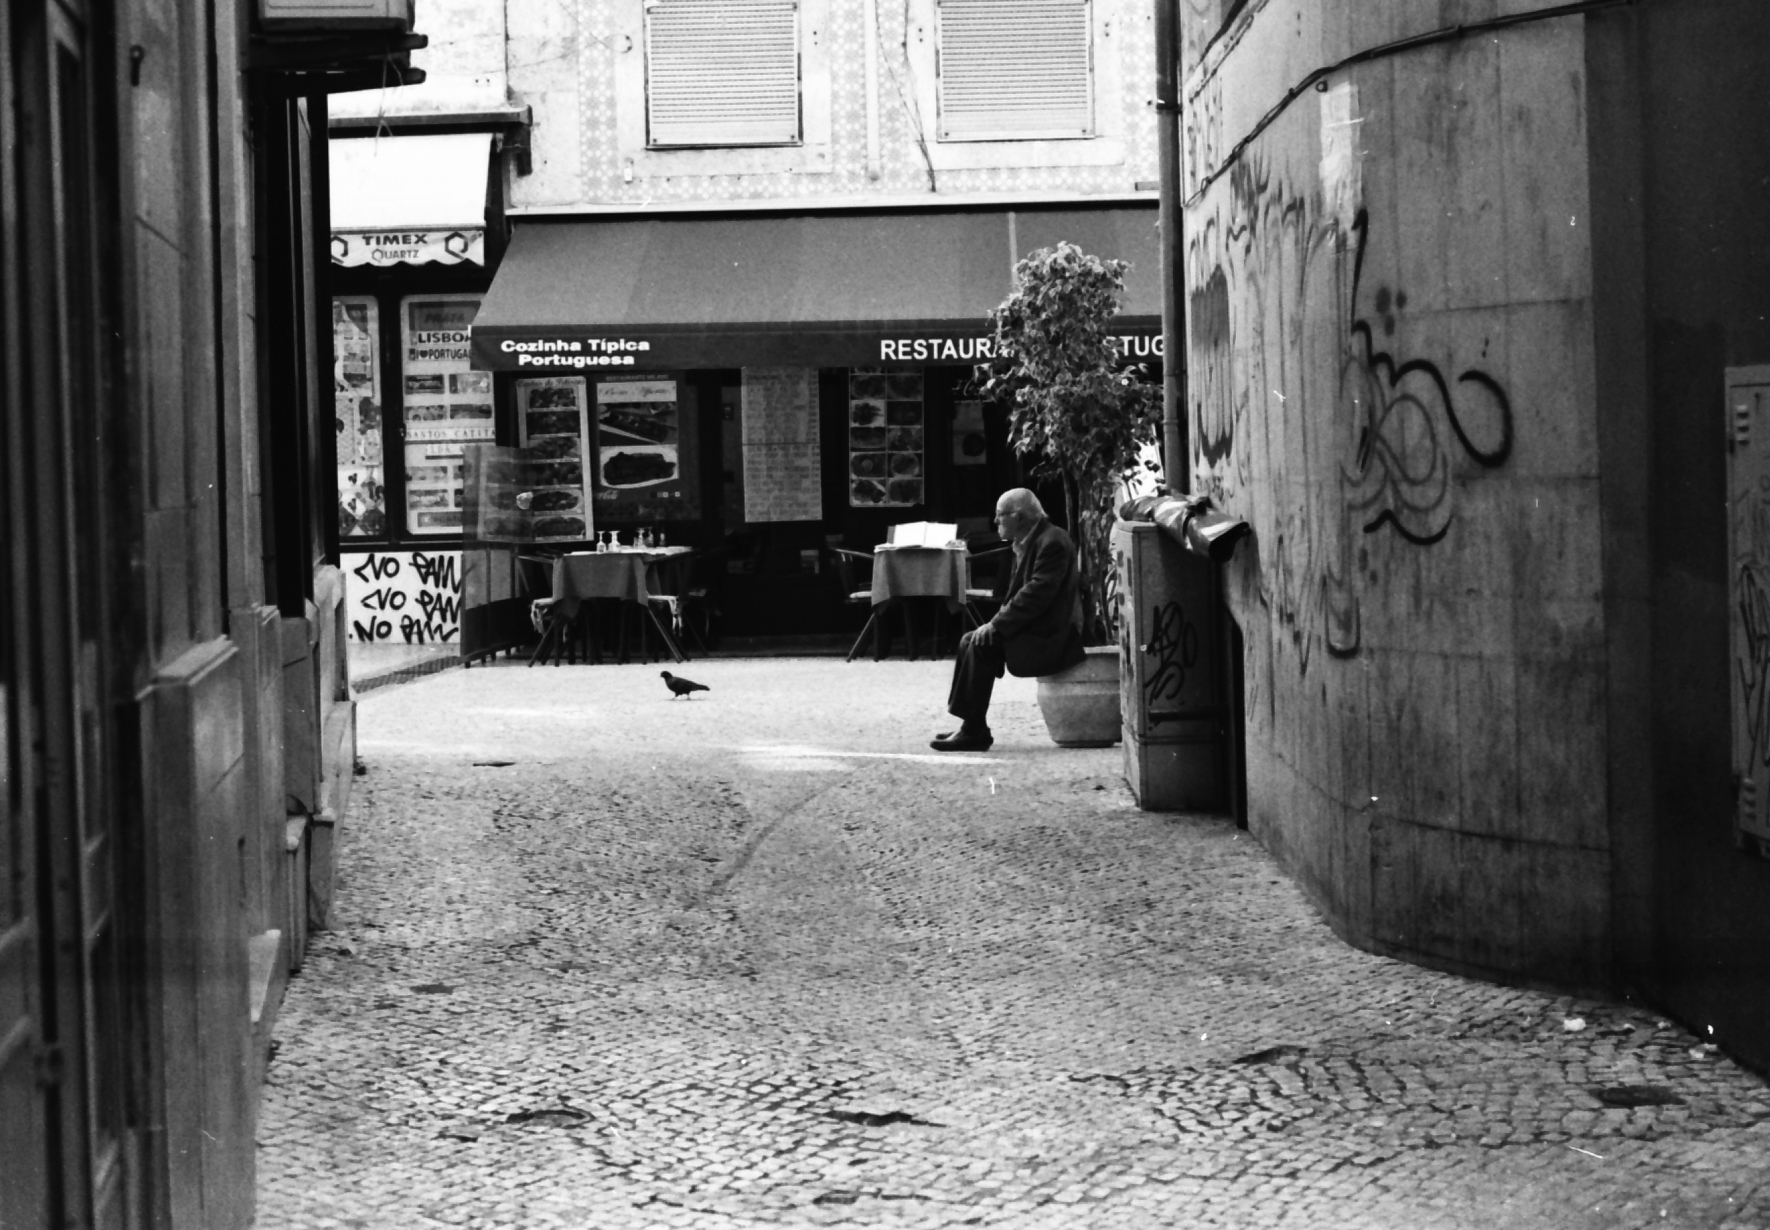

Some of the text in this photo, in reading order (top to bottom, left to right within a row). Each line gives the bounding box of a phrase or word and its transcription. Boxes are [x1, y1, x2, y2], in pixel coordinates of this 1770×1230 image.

[362, 234, 428, 246] TIMEX
[501, 338, 650, 353] Cozinha Típica
[518, 354, 635, 368] Portuguesa
